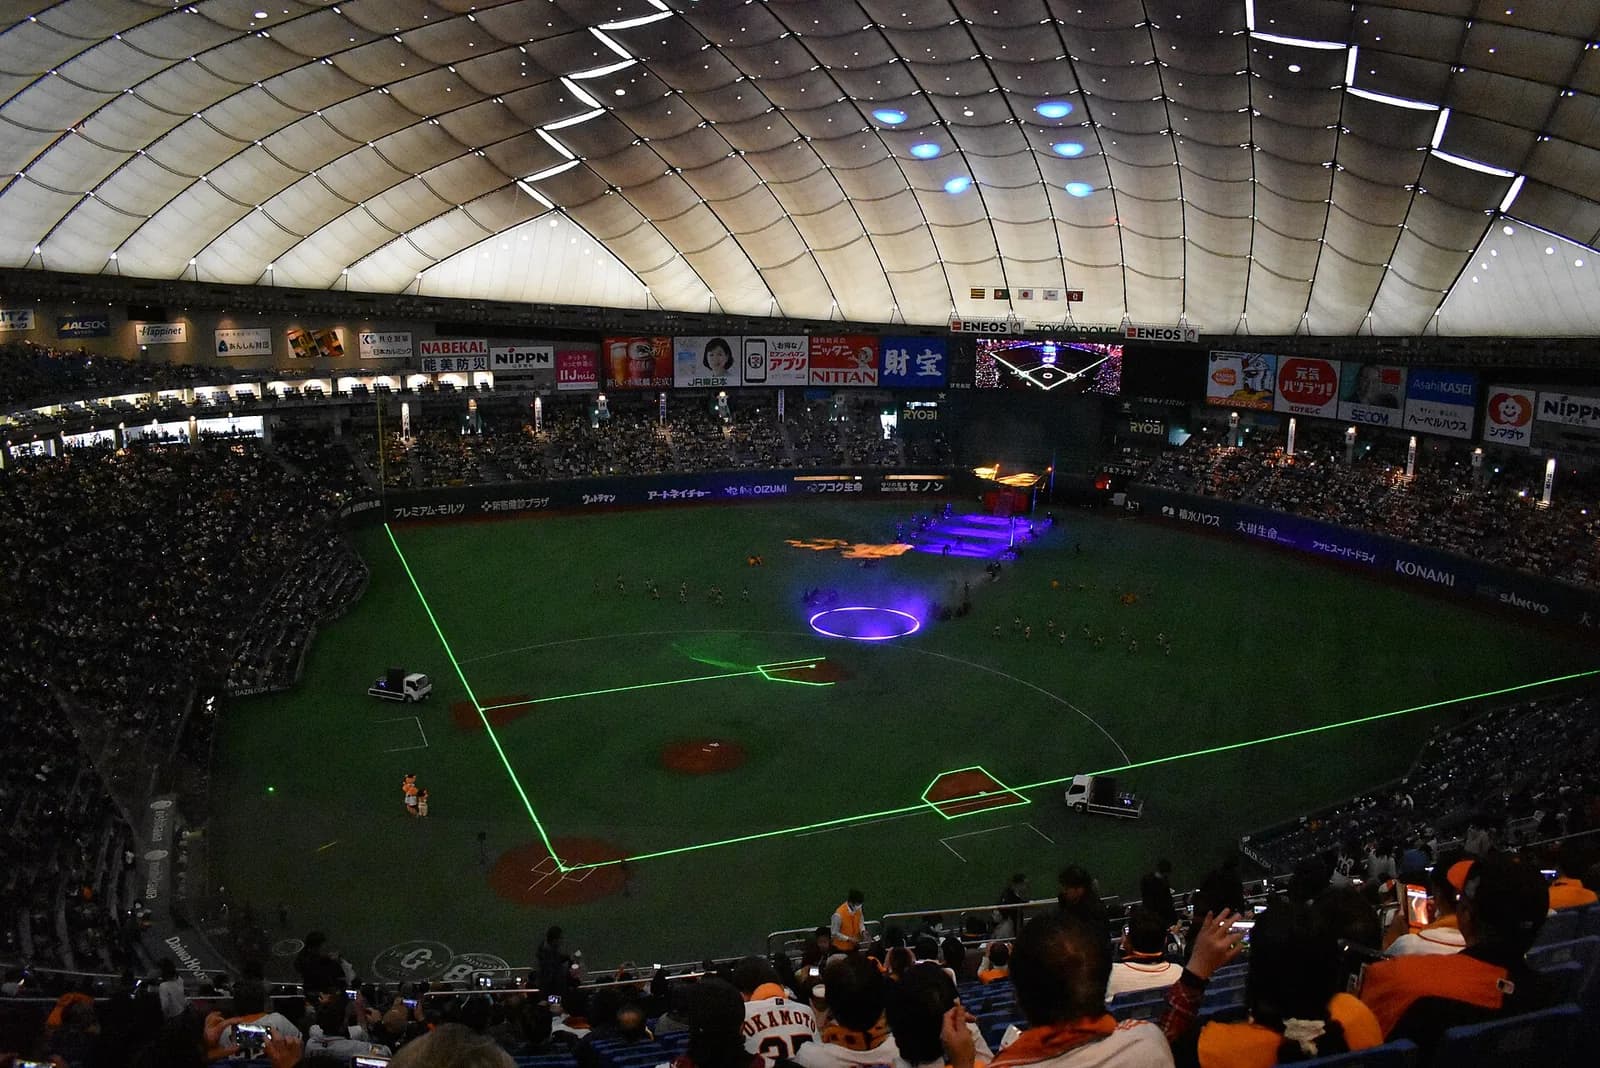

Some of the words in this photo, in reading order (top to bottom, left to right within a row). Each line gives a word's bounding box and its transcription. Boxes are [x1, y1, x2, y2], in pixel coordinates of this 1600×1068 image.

[70, 321, 107, 330] ALSOK
[139, 326, 182, 338] Happinet
[963, 321, 1006, 332] ENEOS
[1138, 328, 1181, 340] ENEOS
[229, 341, 270, 351] あんしん財団
[811, 345, 853, 356] ニッタン
[424, 358, 485, 371] 能美防災
[769, 358, 807, 371] アプリ
[883, 348, 943, 377] 財宝
[560, 369, 596, 381] IIJmio
[811, 371, 876, 384] NITTAN
[1295, 366, 1321, 381] 元気
[688, 377, 728, 387] JR東日本
[903, 409, 938, 421] RYOBI
[1351, 409, 1389, 425] SECOM
[1129, 421, 1165, 435] RYOBI
[1409, 414, 1467, 432] ヘーベルハウス
[1489, 426, 1524, 441] シマダヤ
[647, 488, 712, 500] アートネイチャー
[753, 484, 787, 494] OIZUMI
[1179, 508, 1221, 527] 積水ハウス
[1235, 520, 1278, 541] 大樹生命
[1312, 540, 1376, 563] アサヒスーパードライ
[1395, 559, 1455, 587] KONAMI
[1499, 591, 1550, 614] SANKYO
[164, 936, 192, 962] Daiwa
[743, 1010, 816, 1037] OKAMOTO
